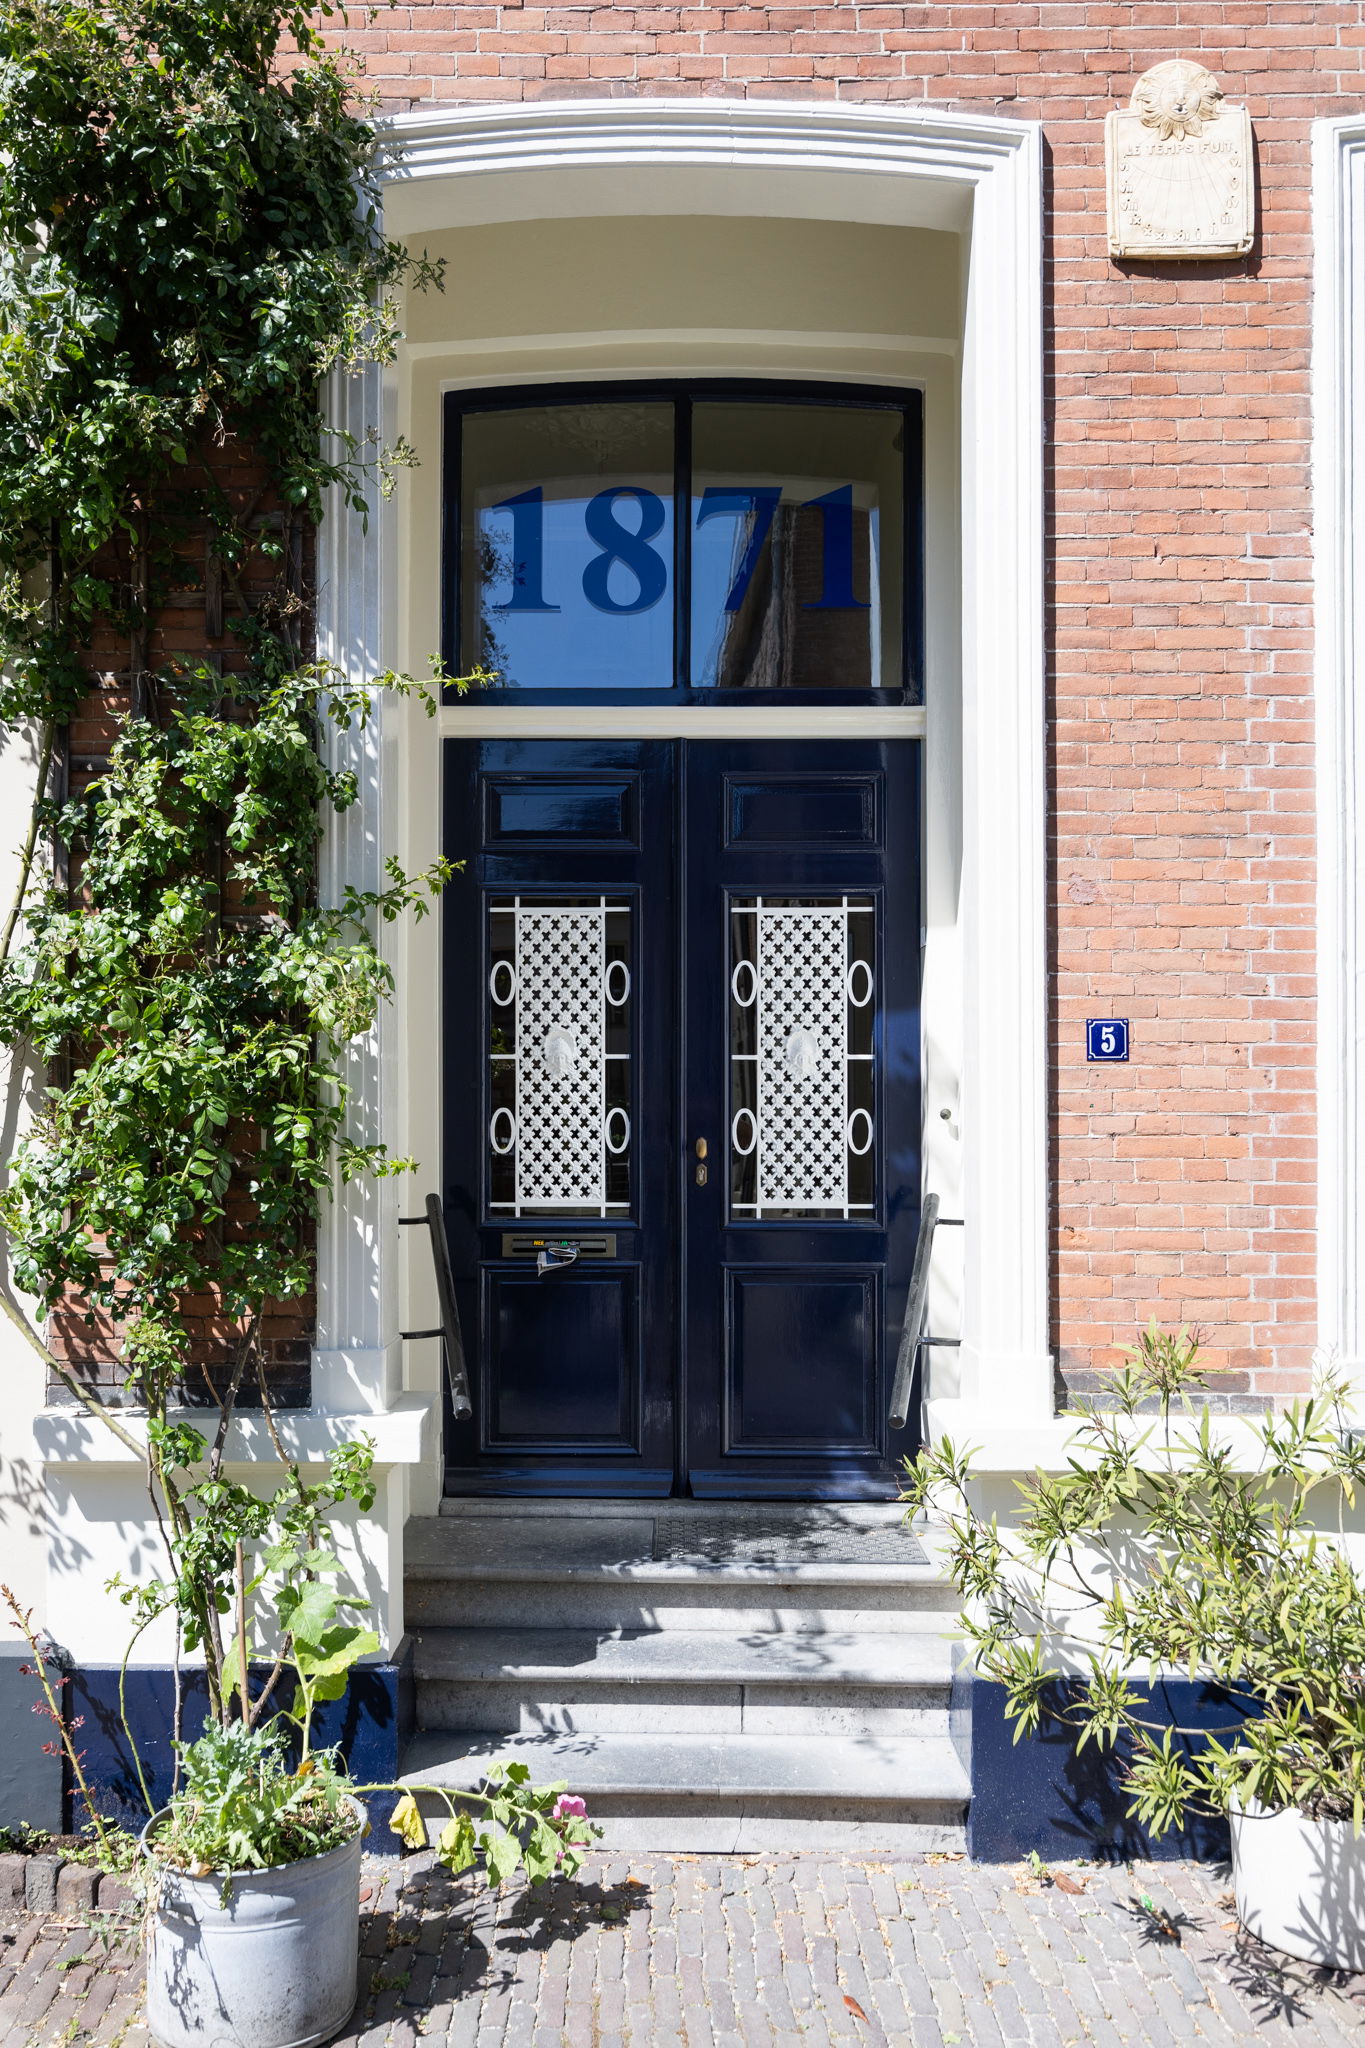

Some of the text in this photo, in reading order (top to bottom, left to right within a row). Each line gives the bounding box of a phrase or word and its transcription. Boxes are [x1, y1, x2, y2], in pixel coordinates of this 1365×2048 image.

[1149, 144, 1194, 156] TEMPS
[1200, 142, 1233, 154] FUIT
[492, 484, 872, 613] 1871
[1101, 1026, 1116, 1053] 5
